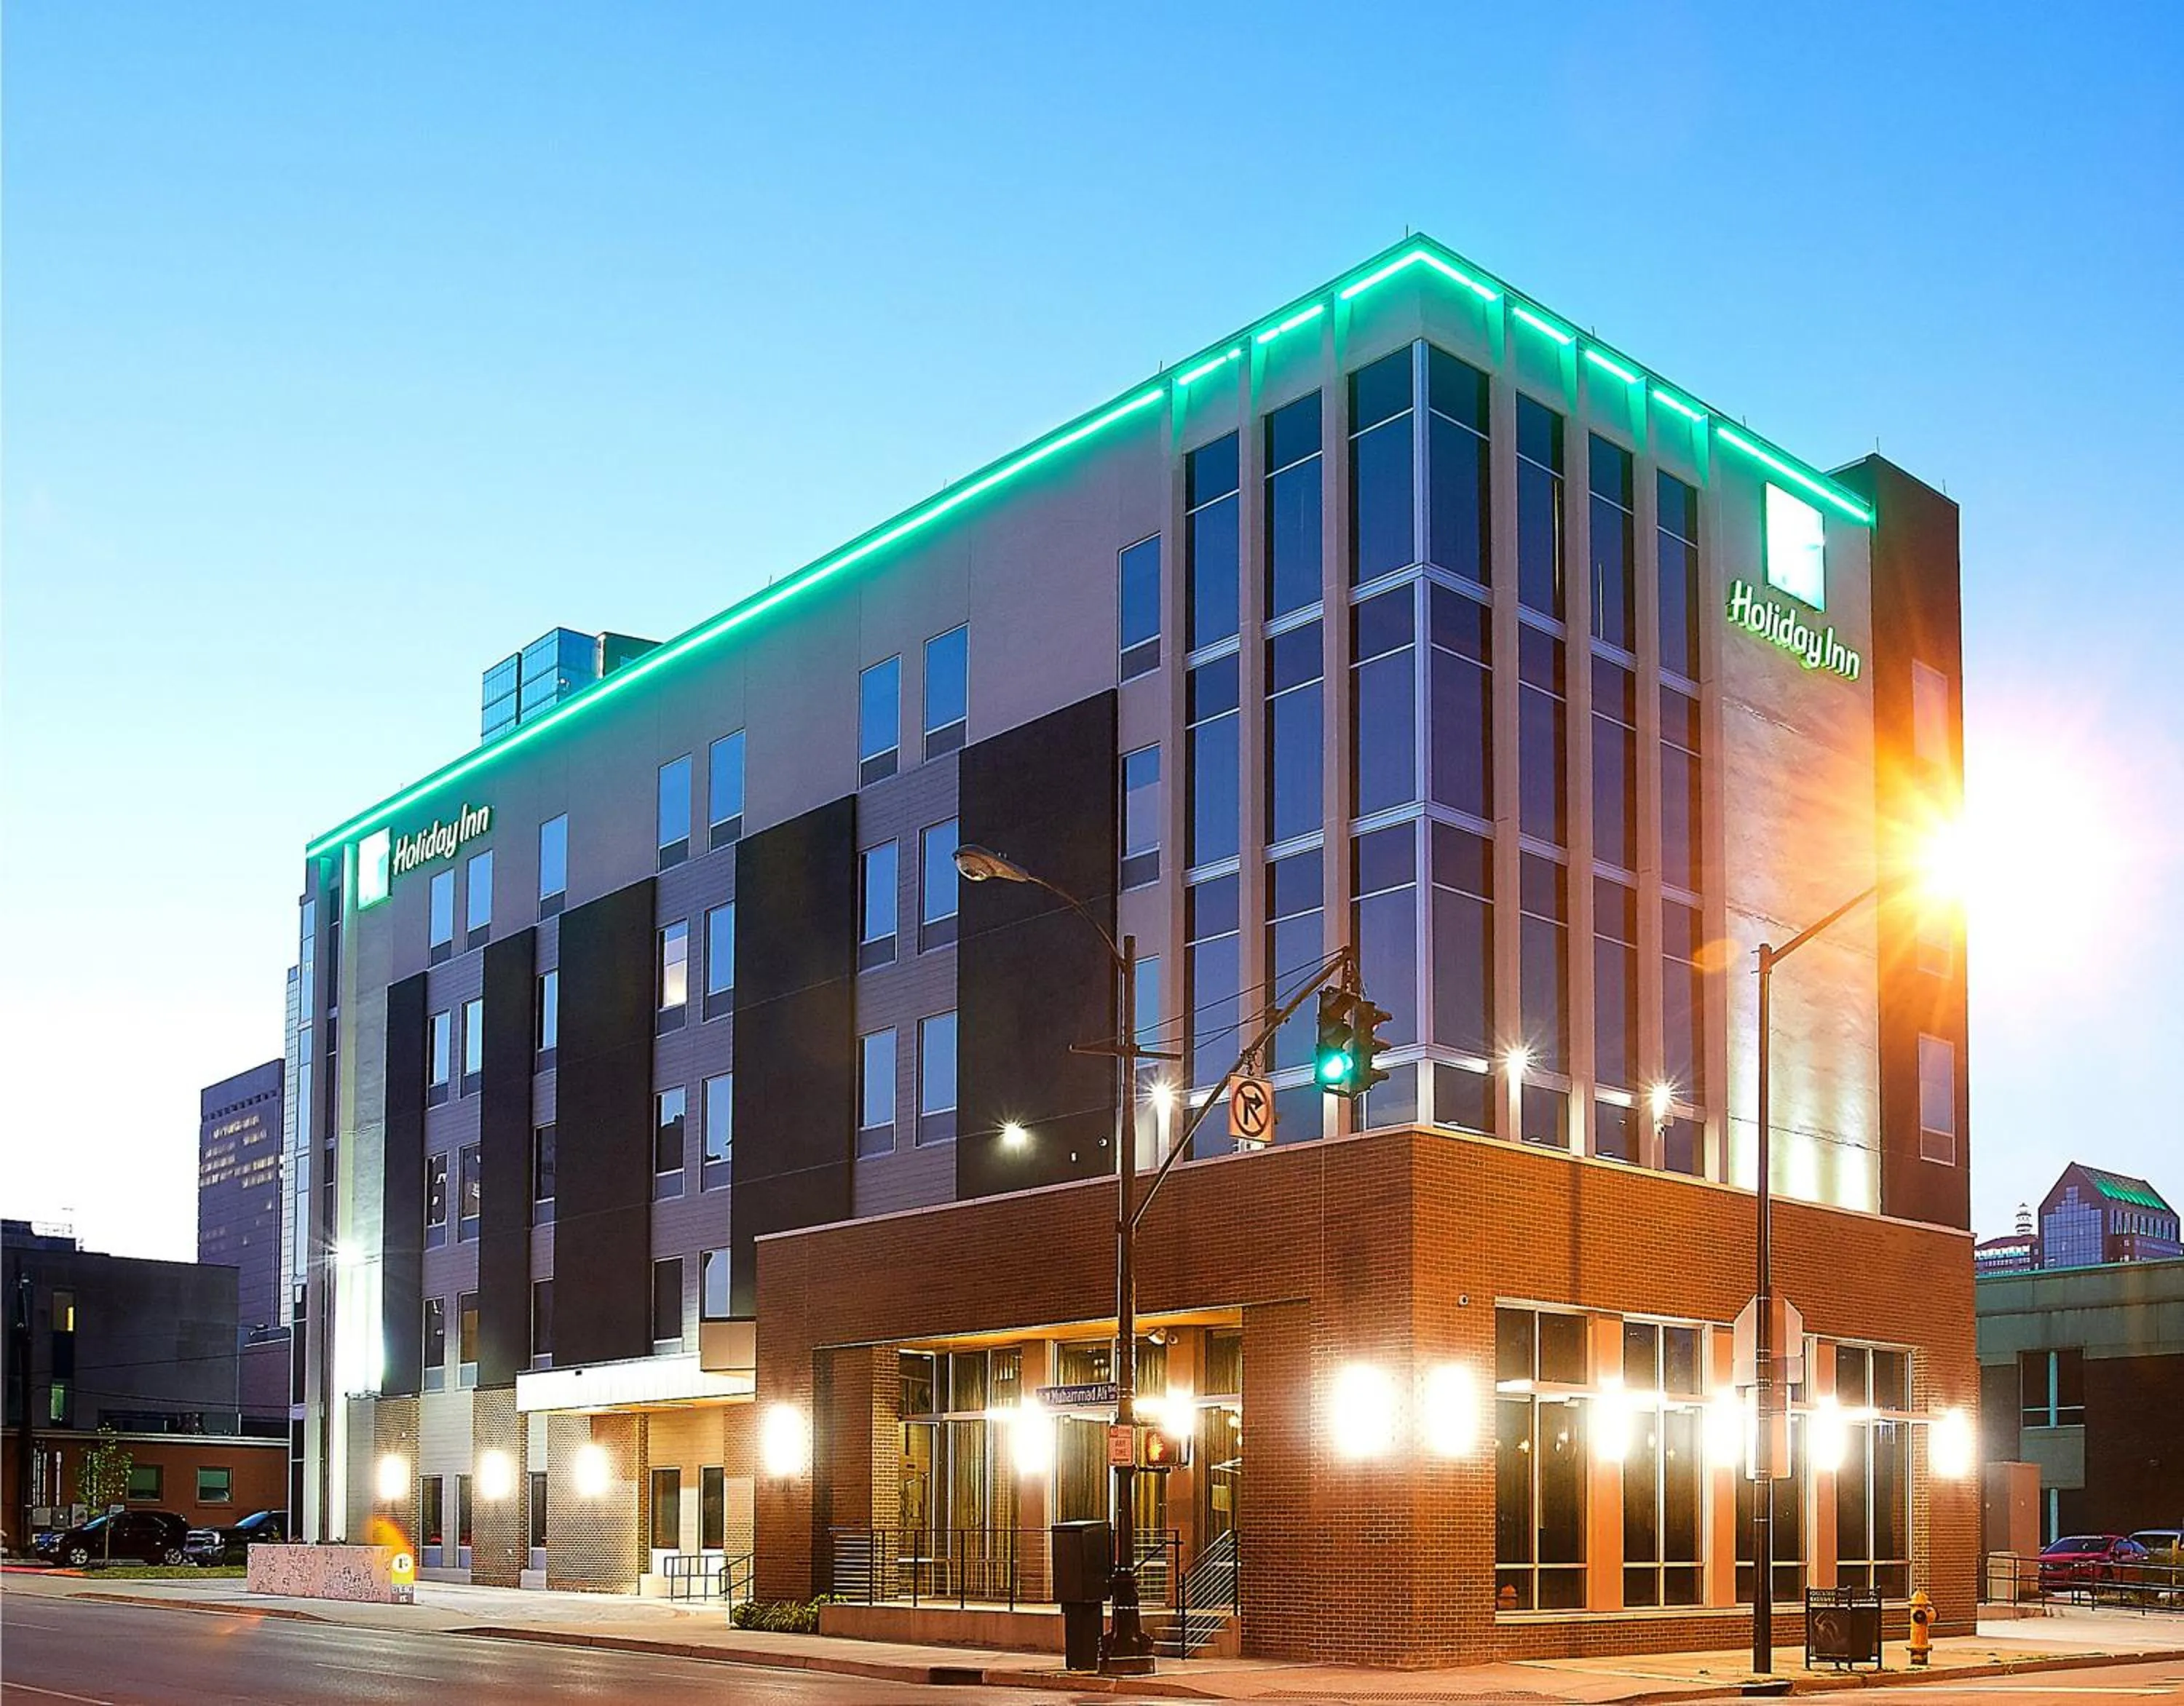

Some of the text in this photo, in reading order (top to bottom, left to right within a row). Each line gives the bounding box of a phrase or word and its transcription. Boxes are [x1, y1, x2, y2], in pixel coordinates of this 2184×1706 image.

[1728, 579, 1860, 680] Holiday Inn
[392, 803, 490, 876] Holiday Inn
[1050, 1385, 1107, 1404] Muhammad Ali
